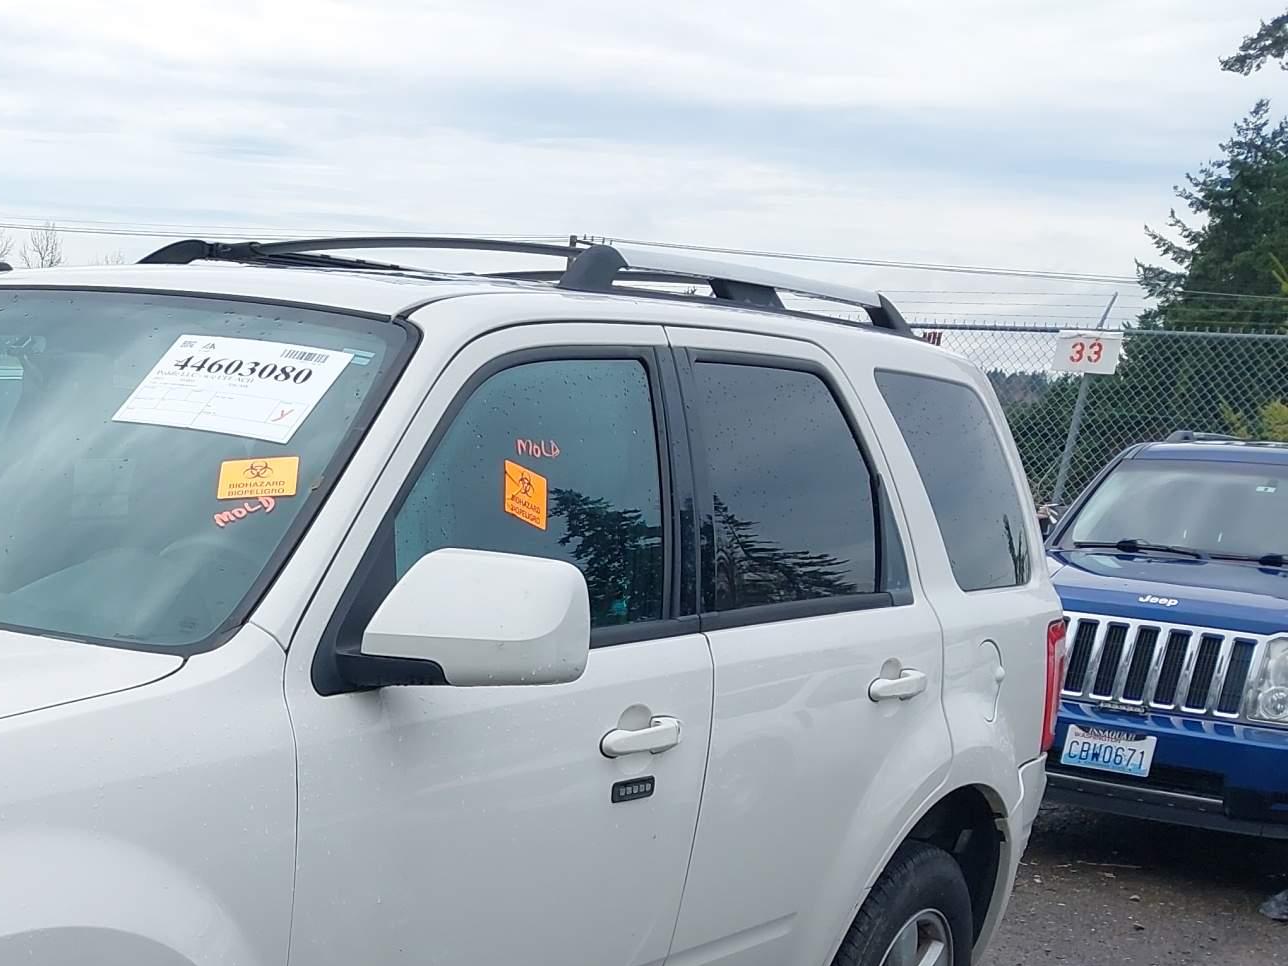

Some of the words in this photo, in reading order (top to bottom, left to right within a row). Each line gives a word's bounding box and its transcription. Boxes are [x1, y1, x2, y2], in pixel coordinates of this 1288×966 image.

[1069, 341, 1103, 363] 33
[174, 355, 312, 385] 44603080
[227, 488, 285, 497] BIOPELIGRO
[229, 480, 286, 489] BIOHAZARD
[1138, 595, 1179, 607] Jeep
[1068, 740, 1146, 769] CBW0671
